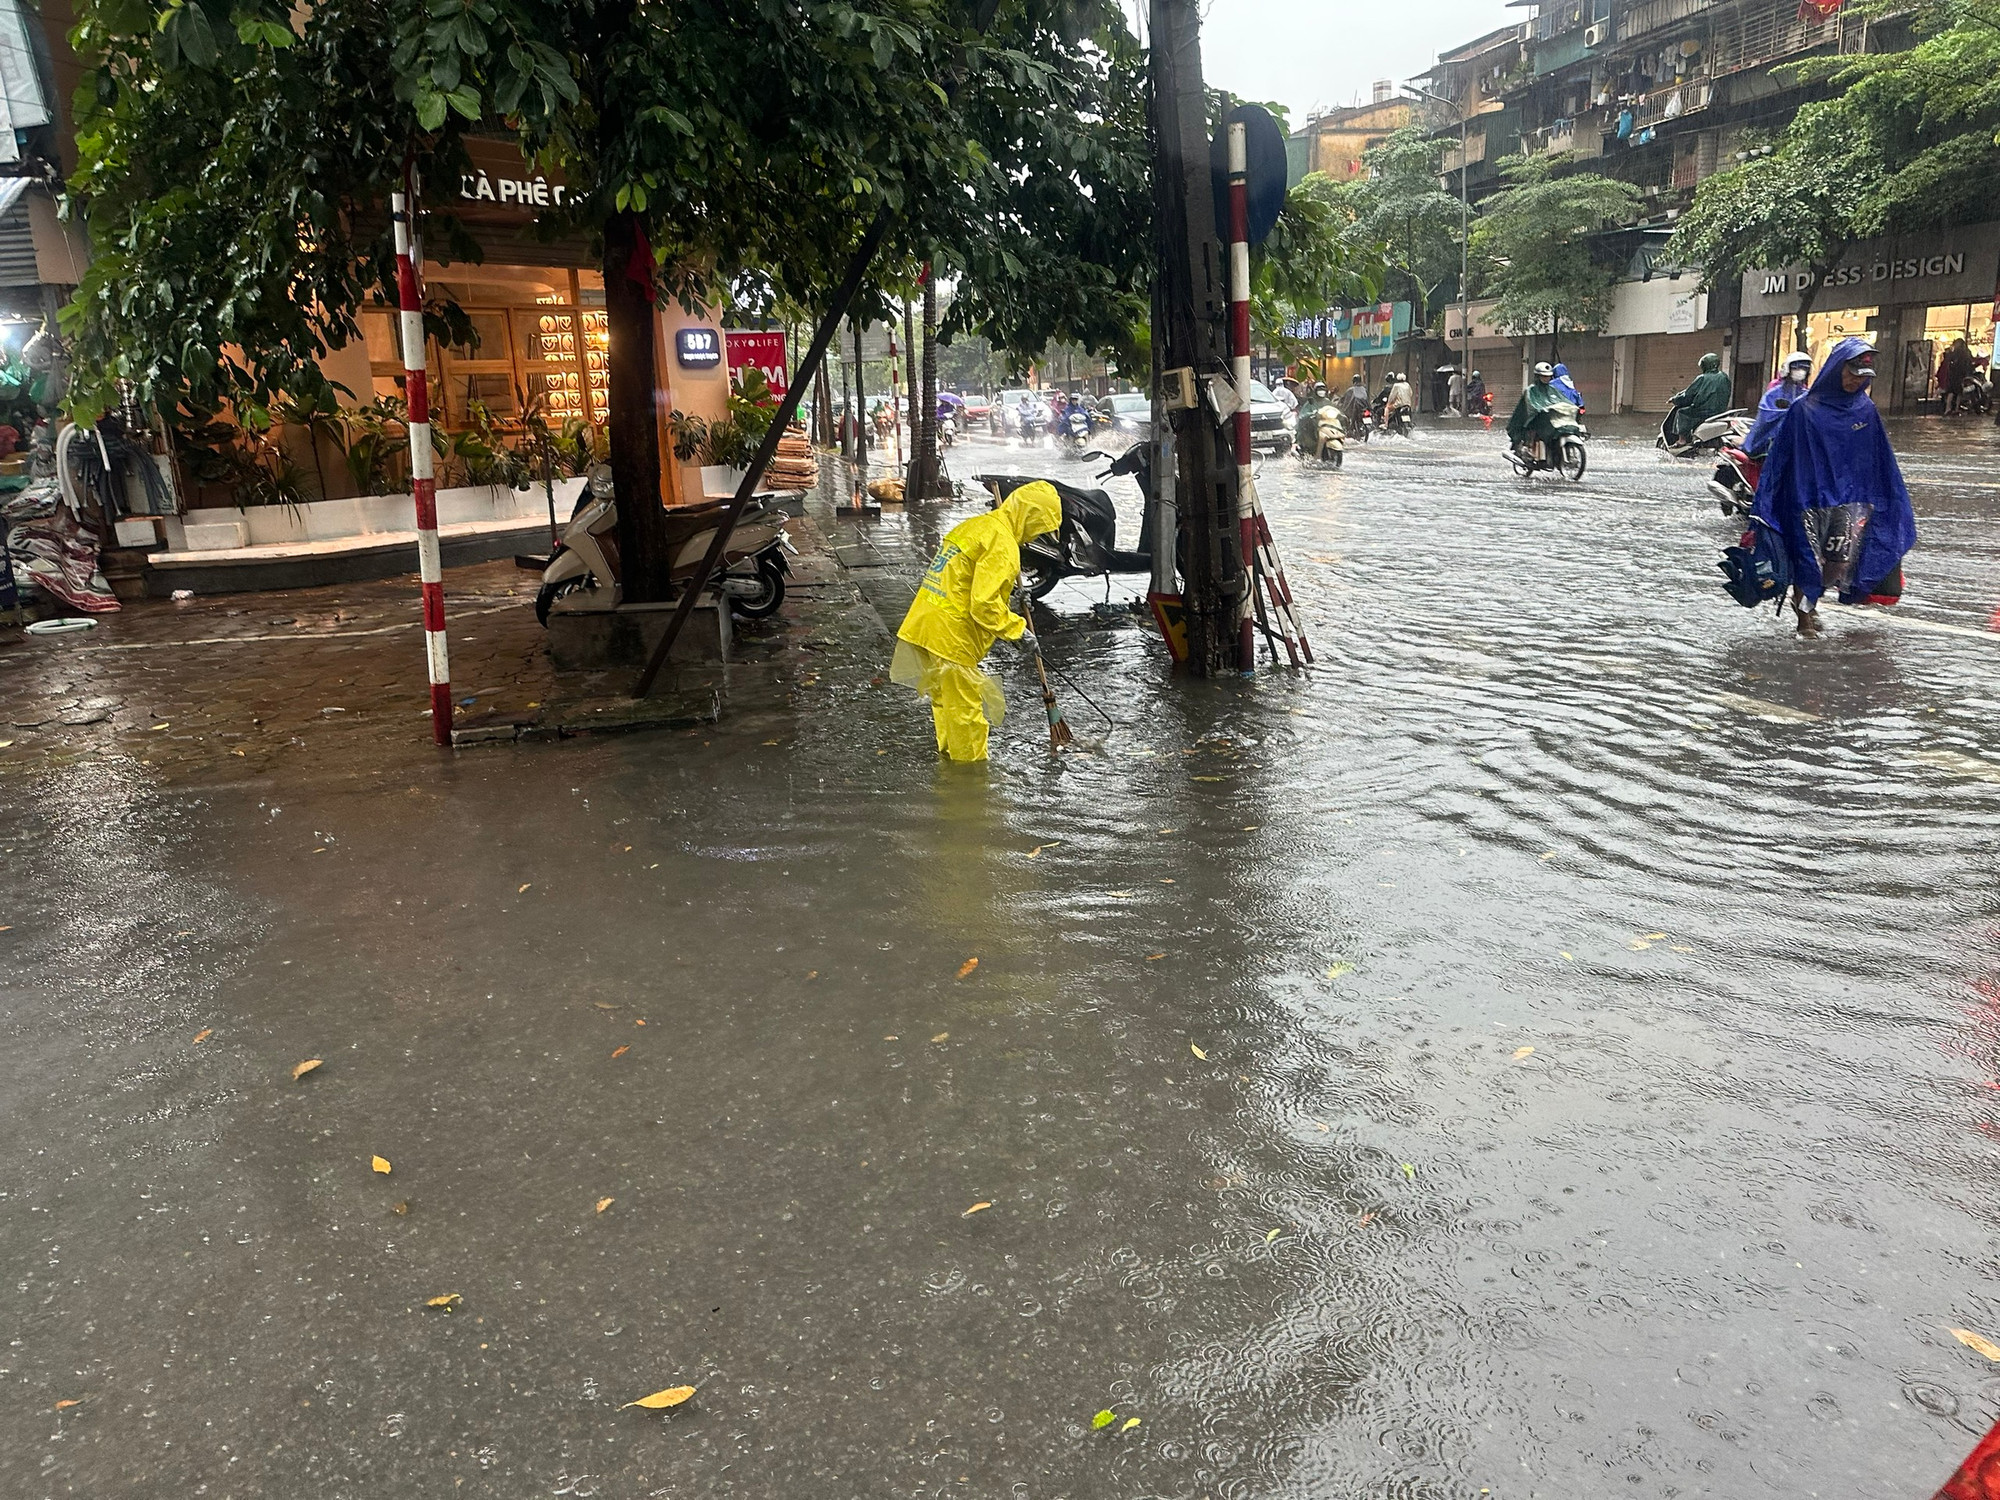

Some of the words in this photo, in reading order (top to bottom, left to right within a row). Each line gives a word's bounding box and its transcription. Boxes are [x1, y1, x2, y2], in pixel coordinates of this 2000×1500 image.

[498, 176, 550, 206] PHÊ
[1760, 274, 1786, 295] JM
[1796, 265, 1862, 291] DESS
[1873, 252, 1964, 282] DESIGN
[725, 338, 779, 348] OKYOLIFE
[1826, 536, 1846, 552] 57
